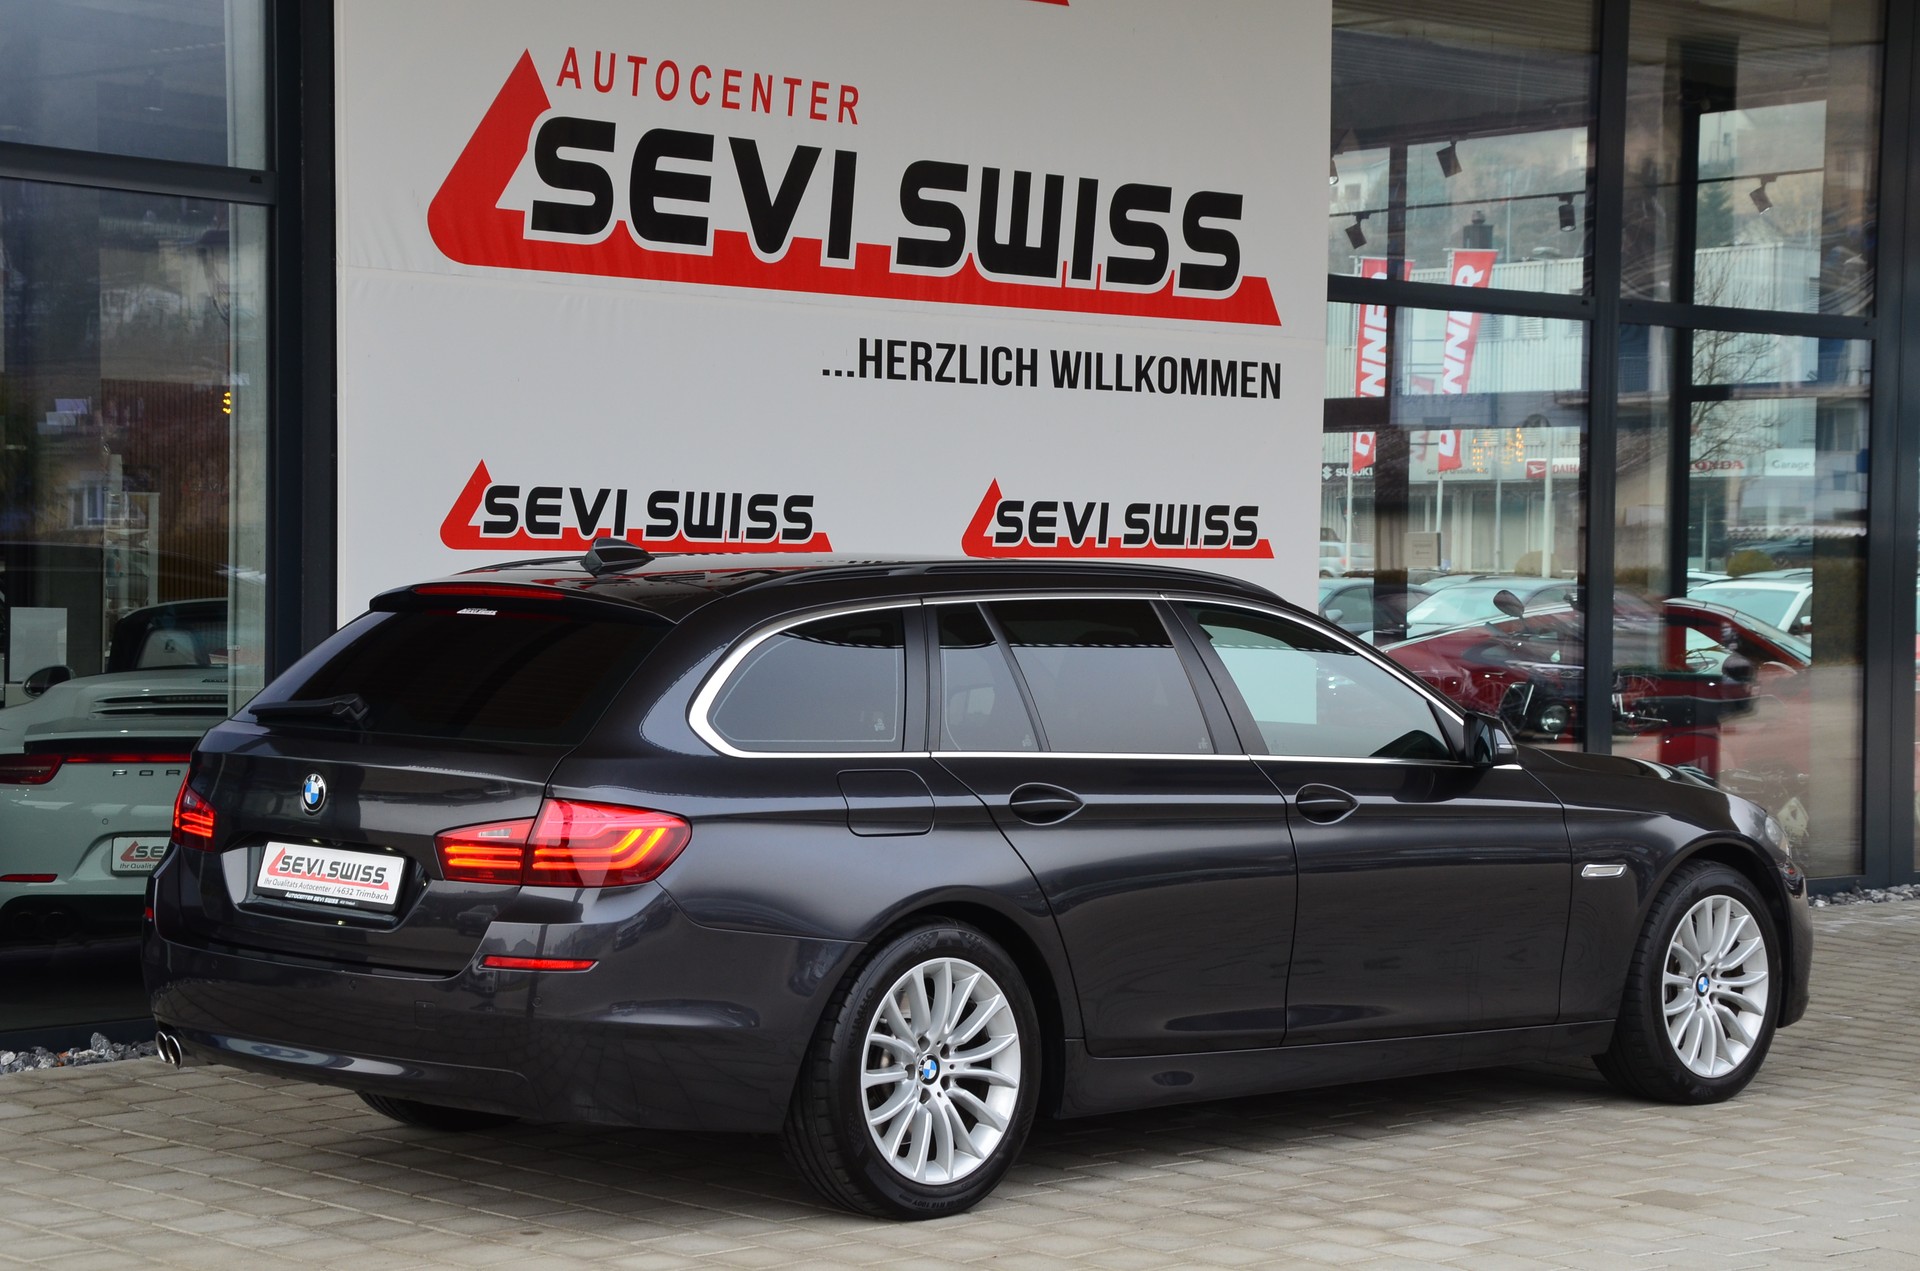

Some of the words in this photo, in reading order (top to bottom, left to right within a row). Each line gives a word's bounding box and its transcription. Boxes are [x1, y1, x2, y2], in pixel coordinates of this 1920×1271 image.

[556, 46, 860, 126] AUTOCENTER
[530, 115, 858, 260] SEVI
[896, 159, 1244, 292] SWISS
[1050, 349, 1281, 400] WILLKOMMEN
[1771, 459, 1810, 471] Garage
[482, 484, 628, 537] SEVI
[644, 490, 815, 541] SWISS
[994, 500, 1110, 545] SEVI
[1122, 502, 1259, 547] SWISS
[279, 855, 325, 876] SEVI
[327, 860, 387, 884] SWISS
[299, 880, 332, 893] Autocenter
[355, 889, 389, 901] Trimbach
